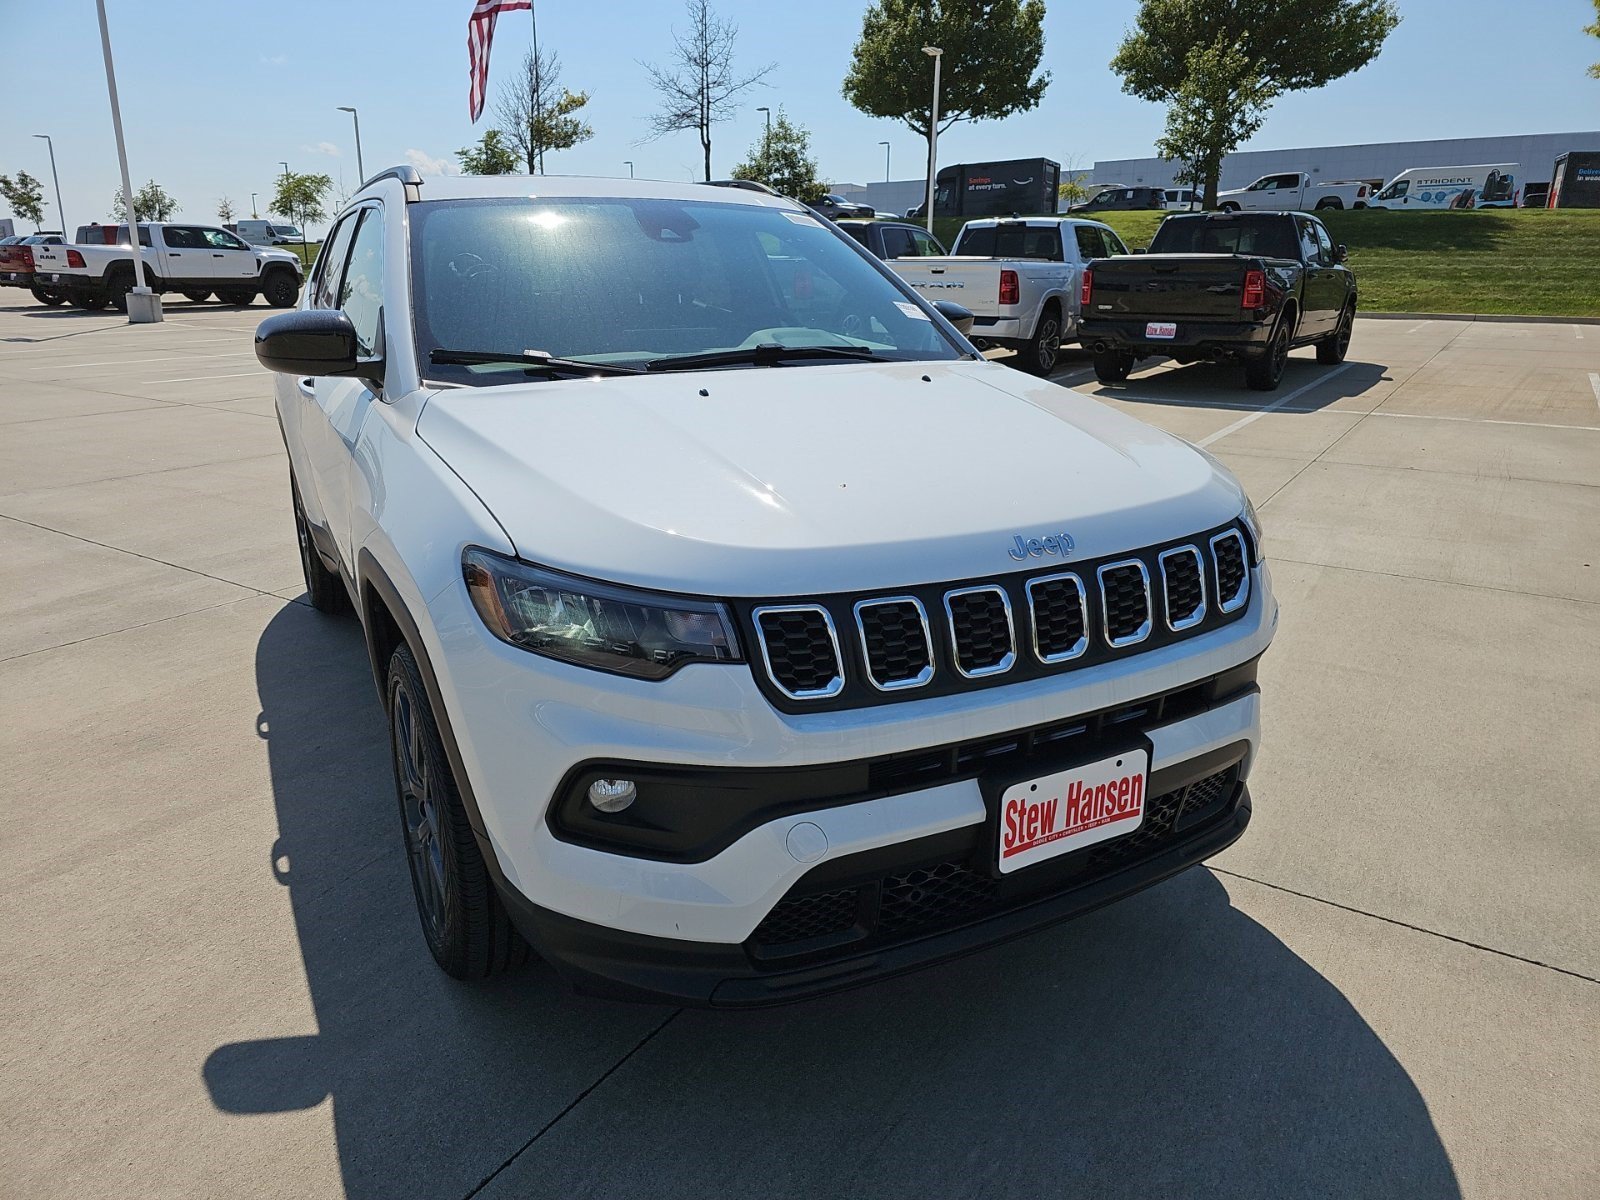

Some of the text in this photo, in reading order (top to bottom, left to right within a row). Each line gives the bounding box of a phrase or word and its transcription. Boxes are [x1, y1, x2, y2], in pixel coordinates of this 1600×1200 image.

[910, 281, 965, 289] RAM
[1008, 533, 1075, 561] Jeep
[1004, 773, 1143, 848] Stew Hansen
[1033, 836, 1048, 846] DODGE
[1062, 825, 1084, 836] CHRYSLER
